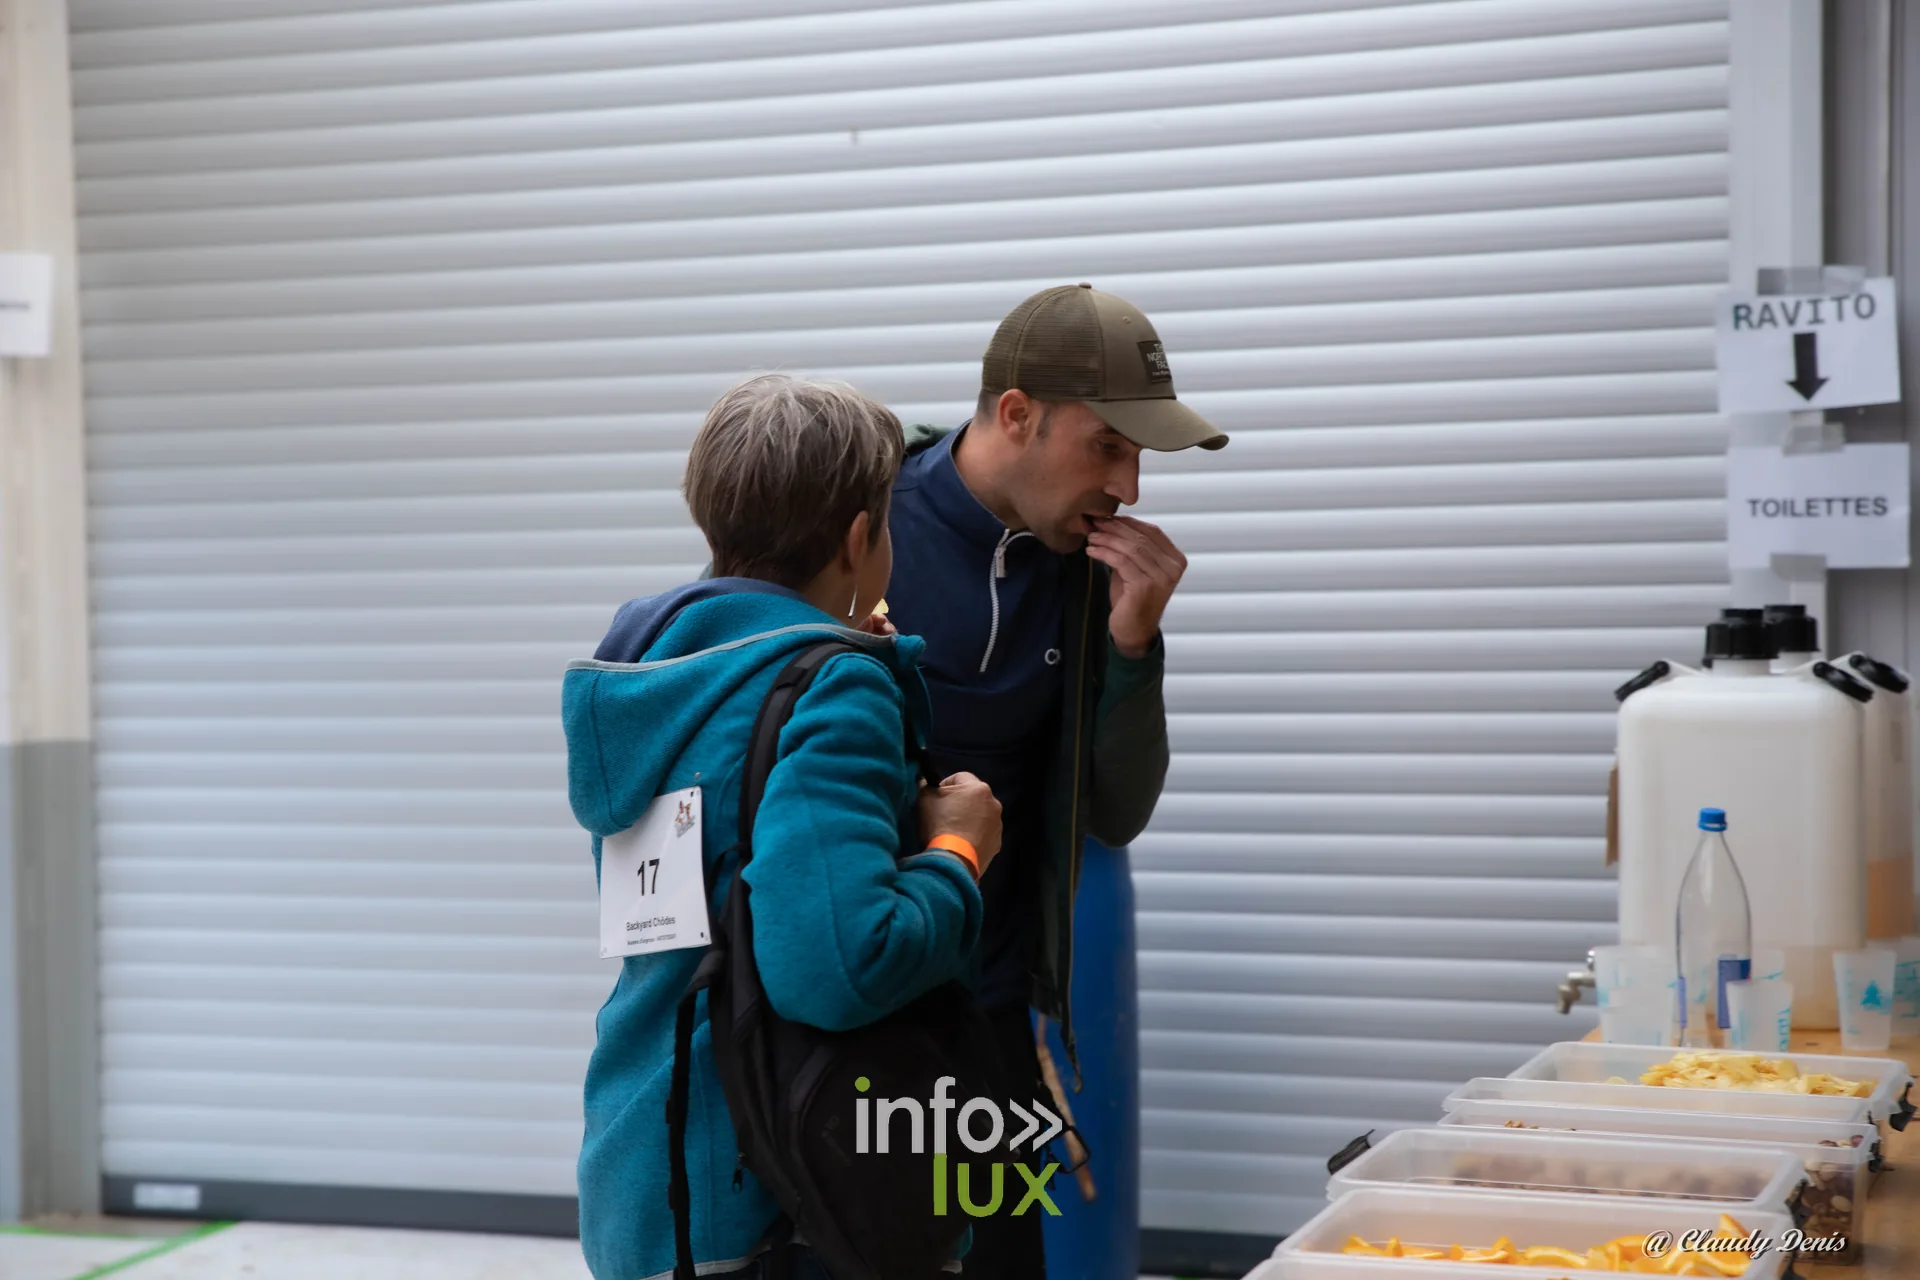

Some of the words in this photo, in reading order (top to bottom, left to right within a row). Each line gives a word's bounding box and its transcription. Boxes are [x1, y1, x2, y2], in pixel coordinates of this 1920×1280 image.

[1732, 292, 1877, 330] RAVITO
[1747, 496, 1889, 518] TOILETTES
[637, 858, 660, 896] 17
[626, 918, 652, 931] Backyard
